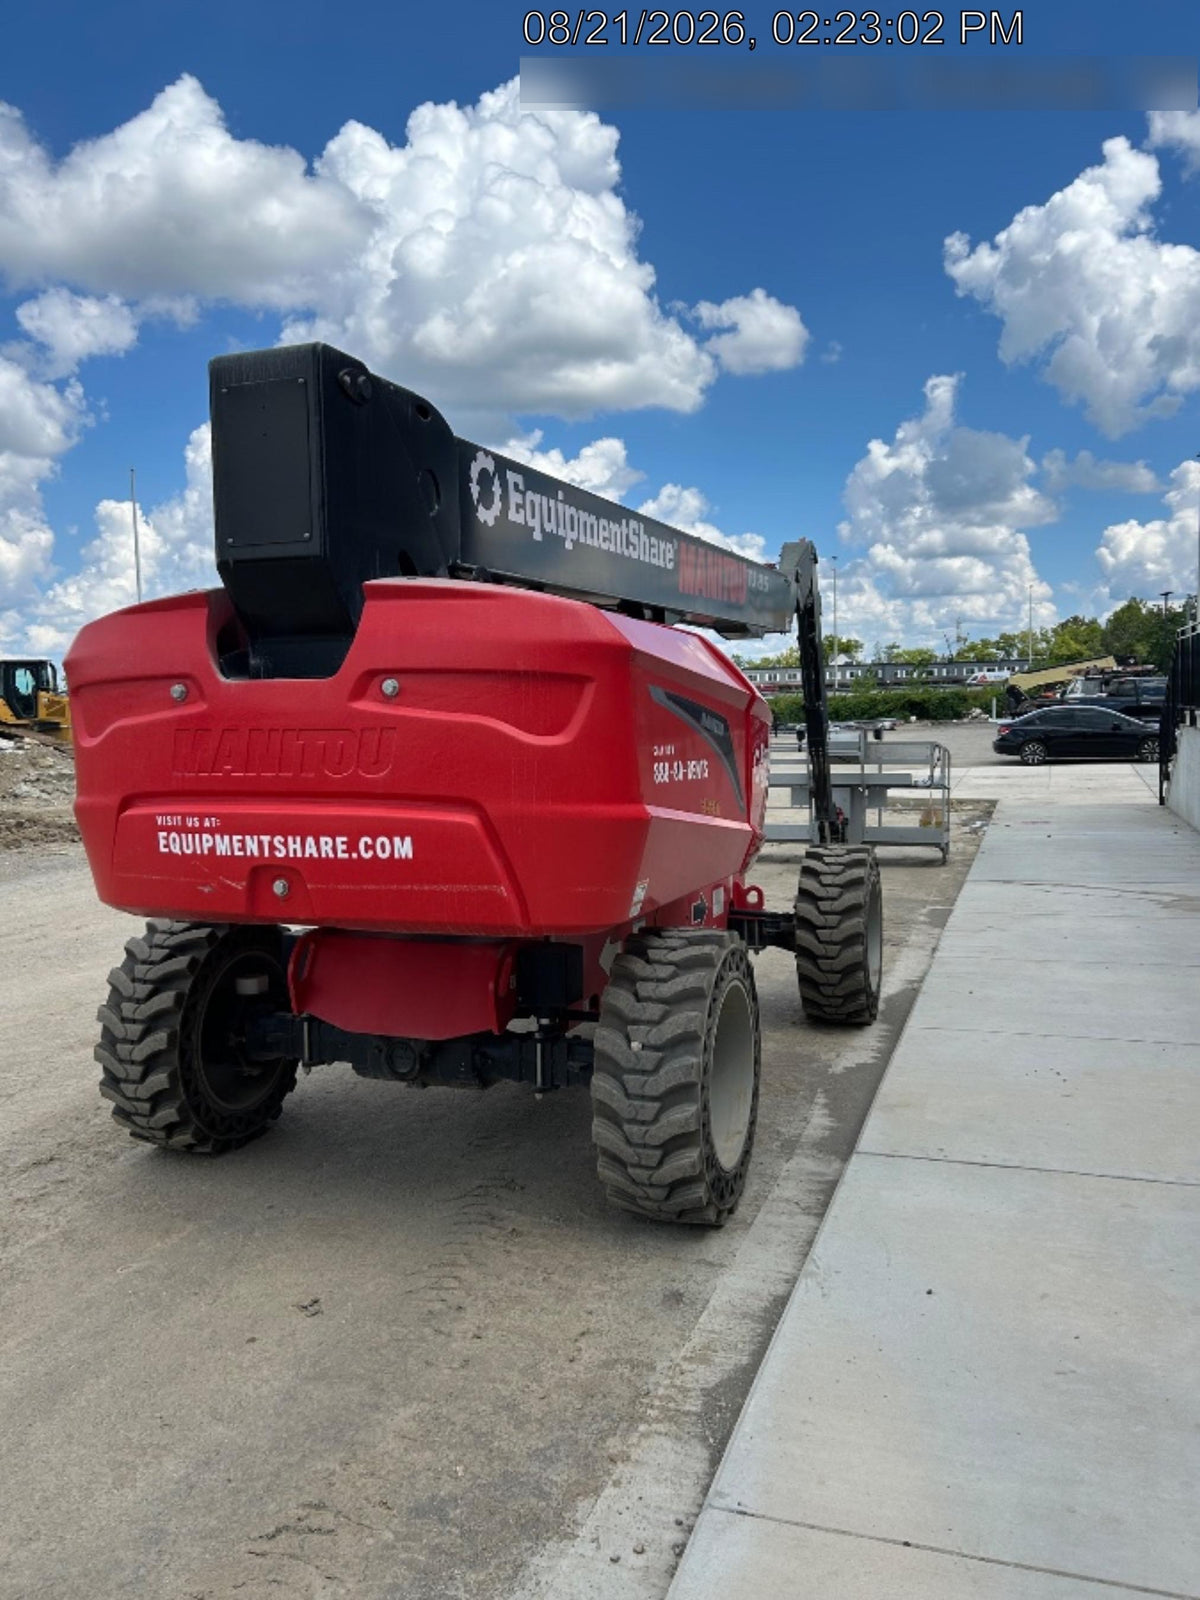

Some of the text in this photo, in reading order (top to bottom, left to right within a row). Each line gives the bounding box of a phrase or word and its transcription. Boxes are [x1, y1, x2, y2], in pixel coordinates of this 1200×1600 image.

[506, 469, 675, 570] EquipmentShare
[156, 815, 221, 828] VISIT US AT:
[158, 831, 413, 860] EQUIPMENTSHARE.COM
